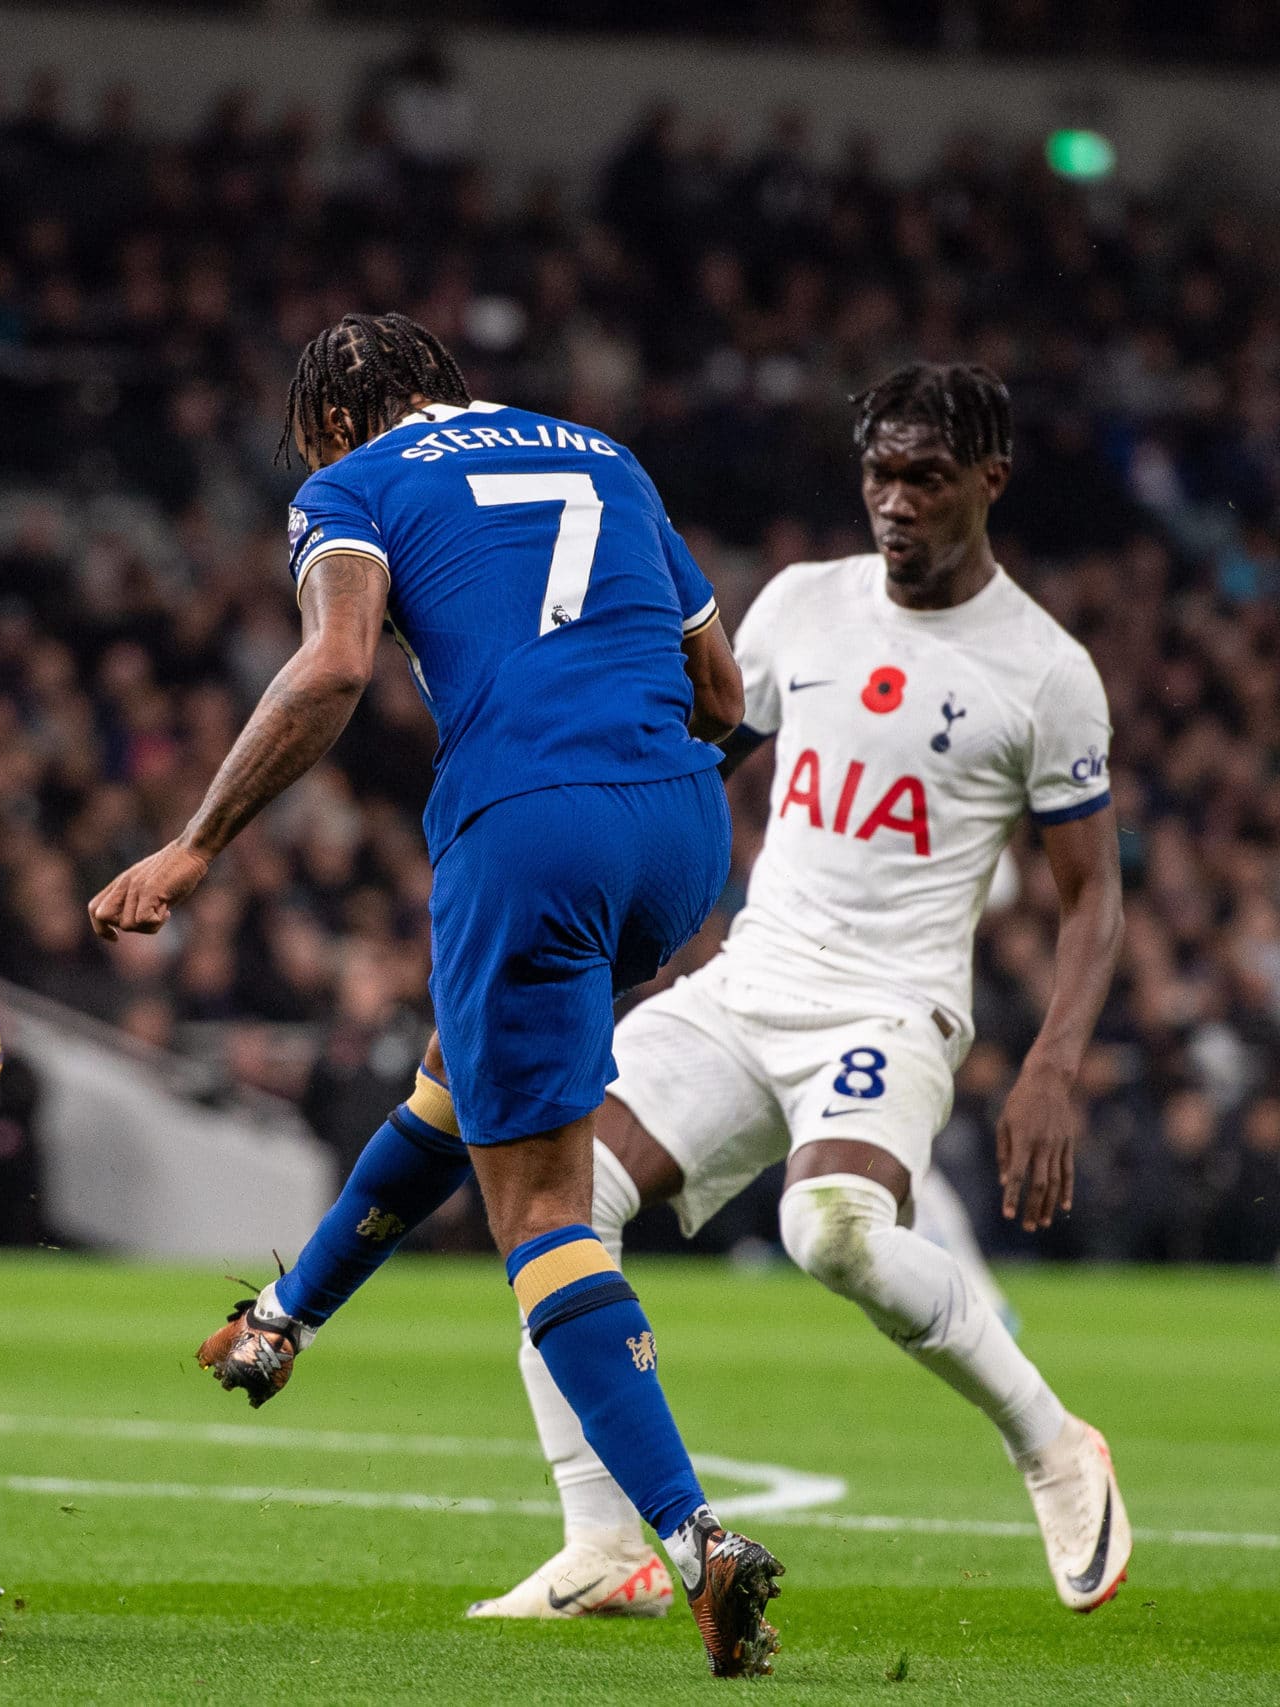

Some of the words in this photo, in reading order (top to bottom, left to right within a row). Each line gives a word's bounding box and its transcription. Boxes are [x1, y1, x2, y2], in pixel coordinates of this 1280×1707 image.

[466, 473, 604, 637] 7
[780, 748, 931, 857] AIA
[833, 1047, 887, 1099] 8
